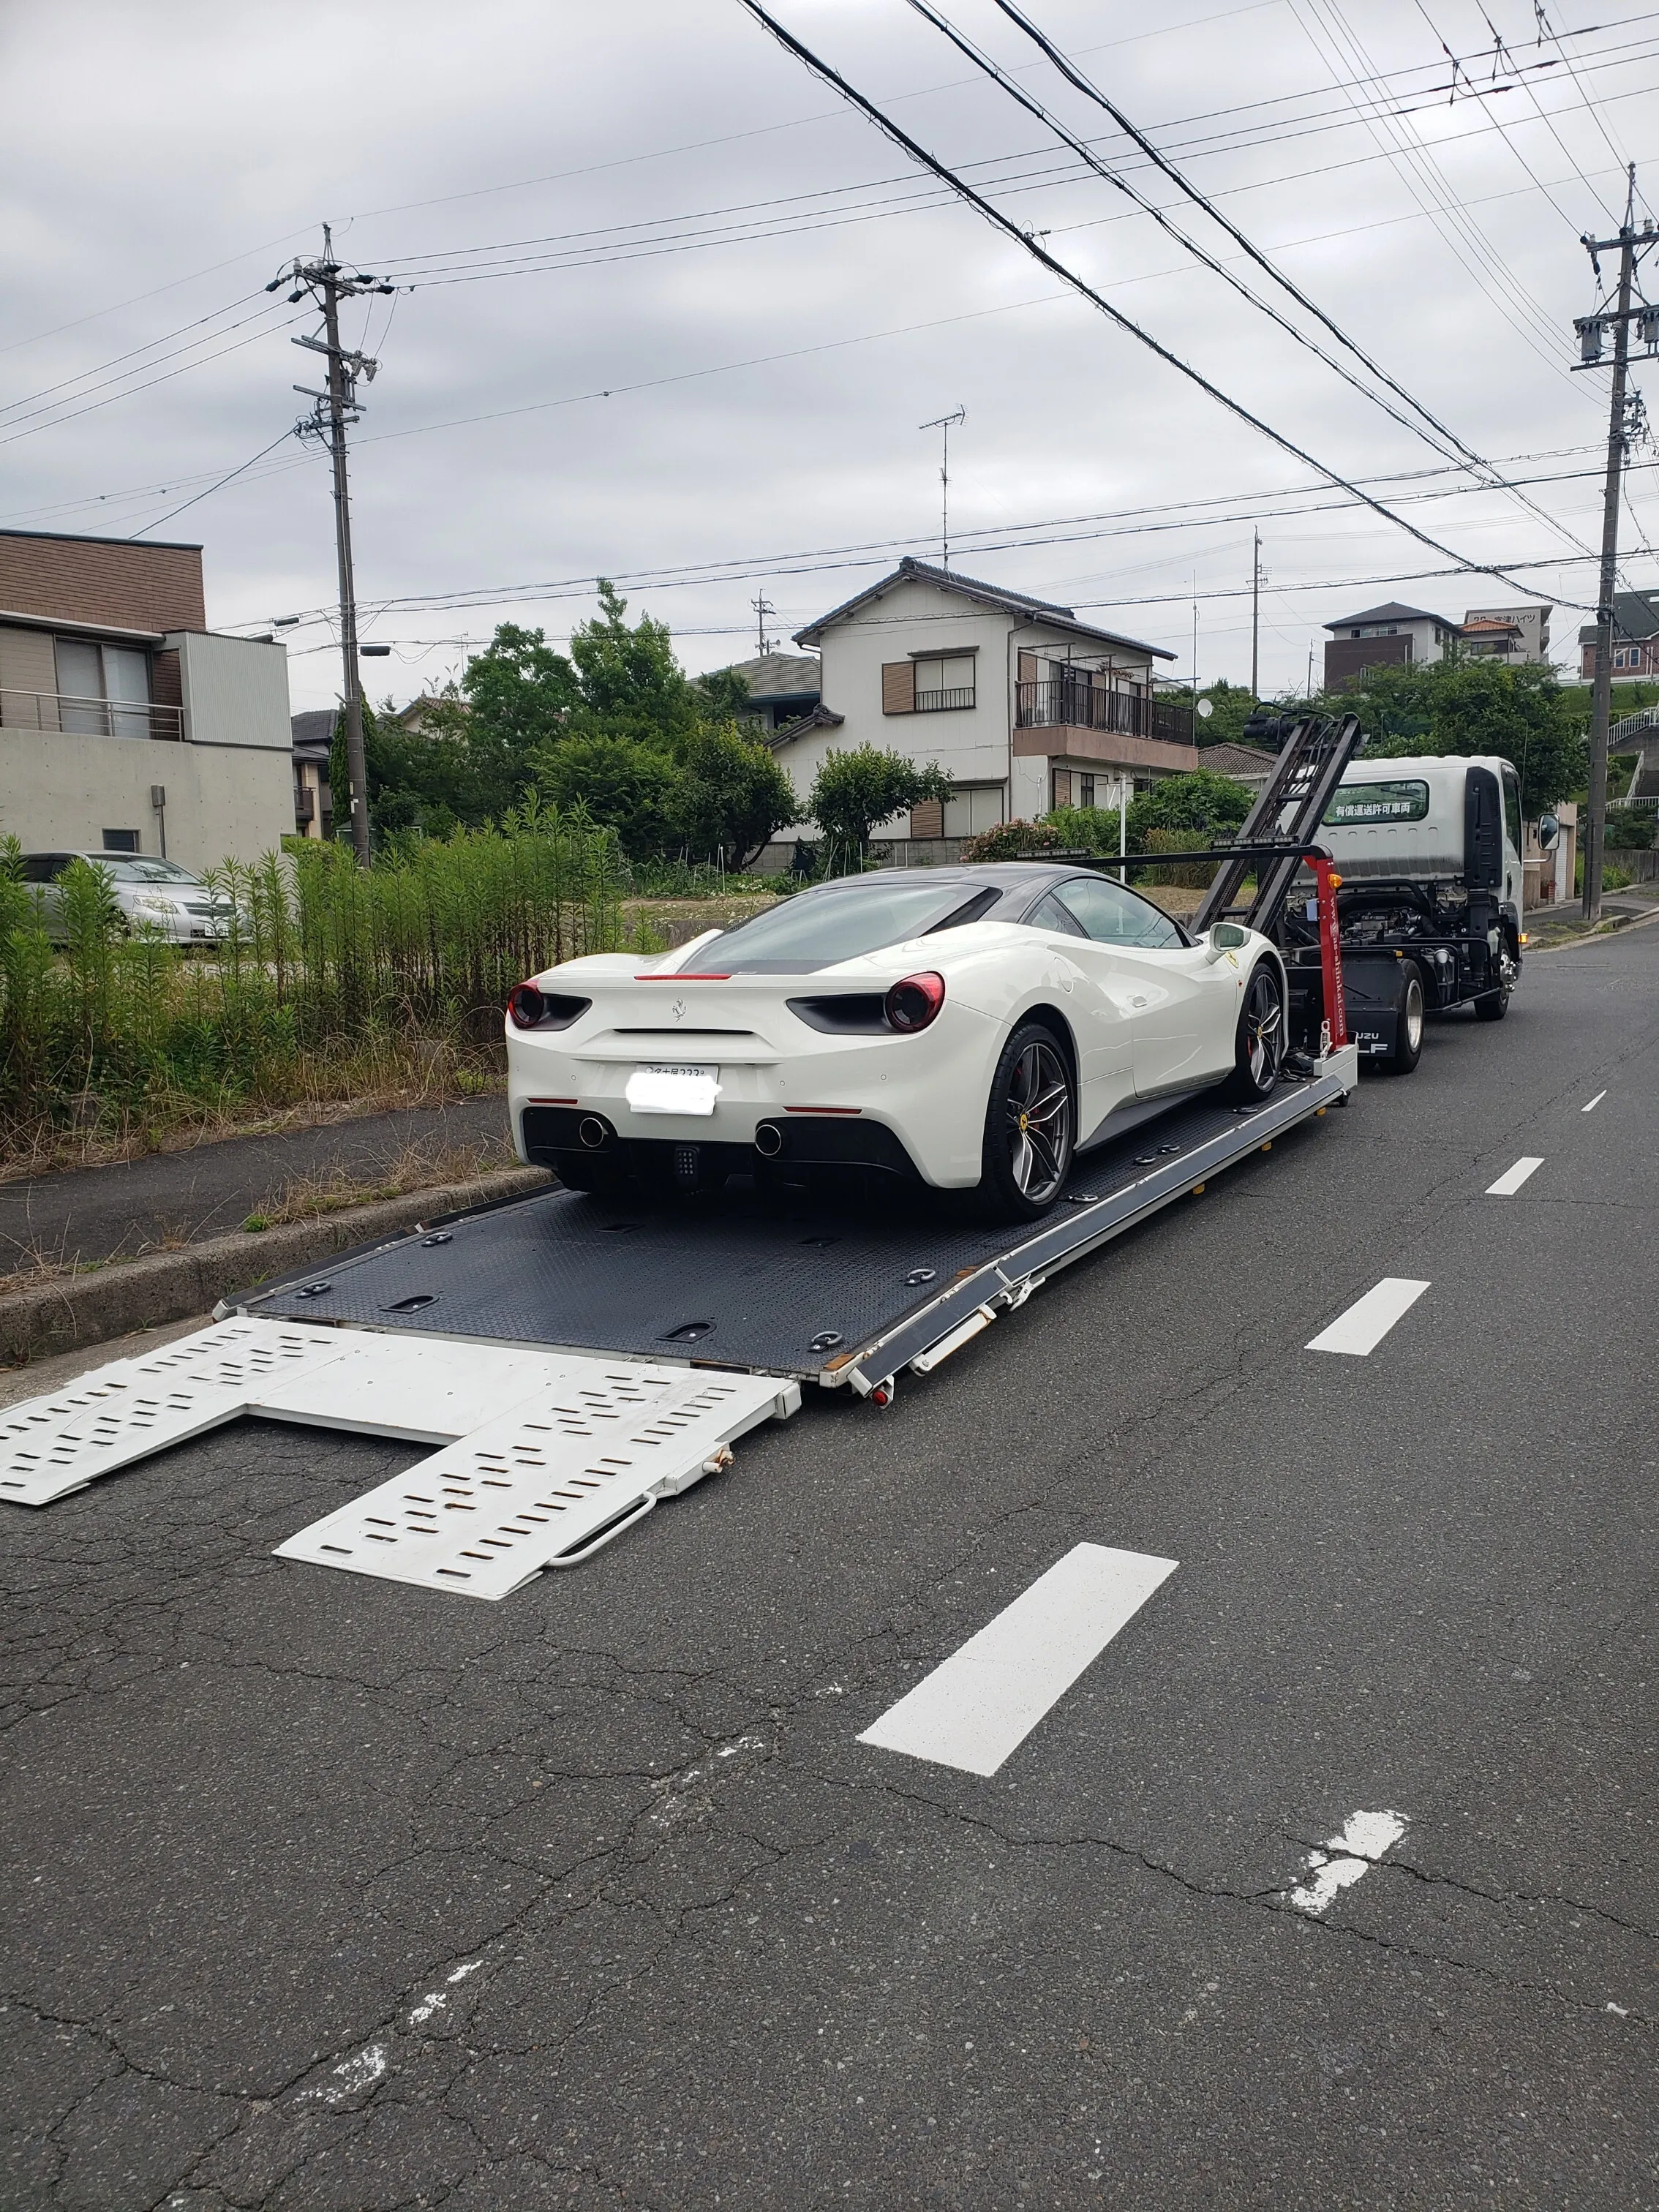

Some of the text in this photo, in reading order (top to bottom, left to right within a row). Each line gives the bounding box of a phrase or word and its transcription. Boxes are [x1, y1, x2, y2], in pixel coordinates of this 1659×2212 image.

[1336, 802, 1411, 816] 有償運送許可車両
[1330, 895, 1344, 1037] www.as-shinkai.com
